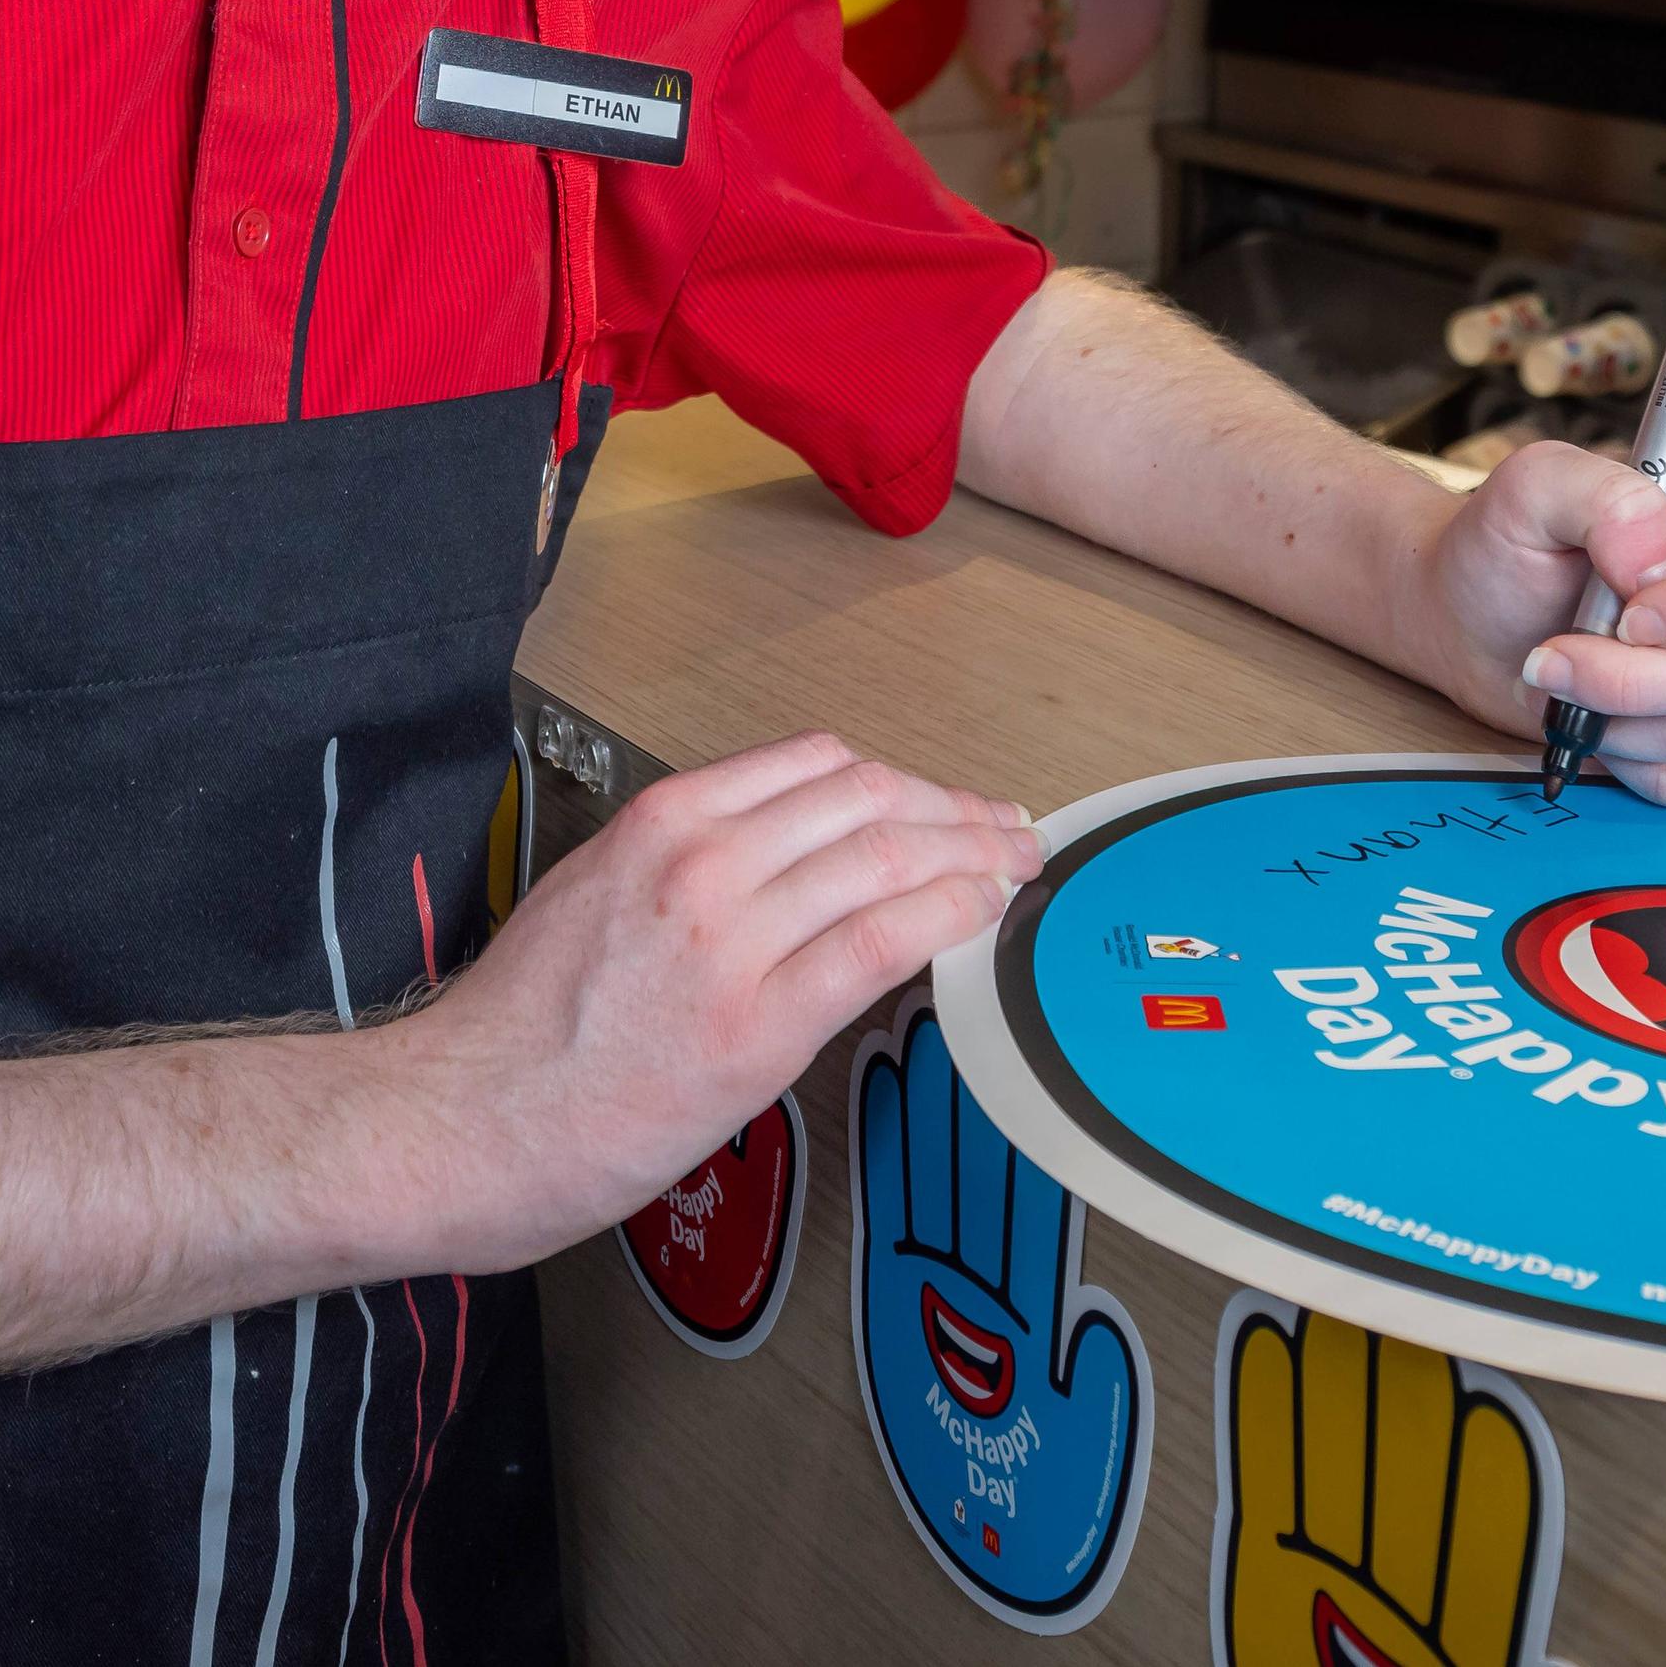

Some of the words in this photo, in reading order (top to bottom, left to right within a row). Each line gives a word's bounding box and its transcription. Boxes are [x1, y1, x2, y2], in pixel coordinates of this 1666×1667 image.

[565, 93, 641, 123] ETHAN
[661, 1167, 724, 1224] Happy
[1322, 1193, 1600, 1291] #McHappyDay
[925, 1381, 1042, 1475] McHappy
[966, 1458, 1017, 1519] Day
